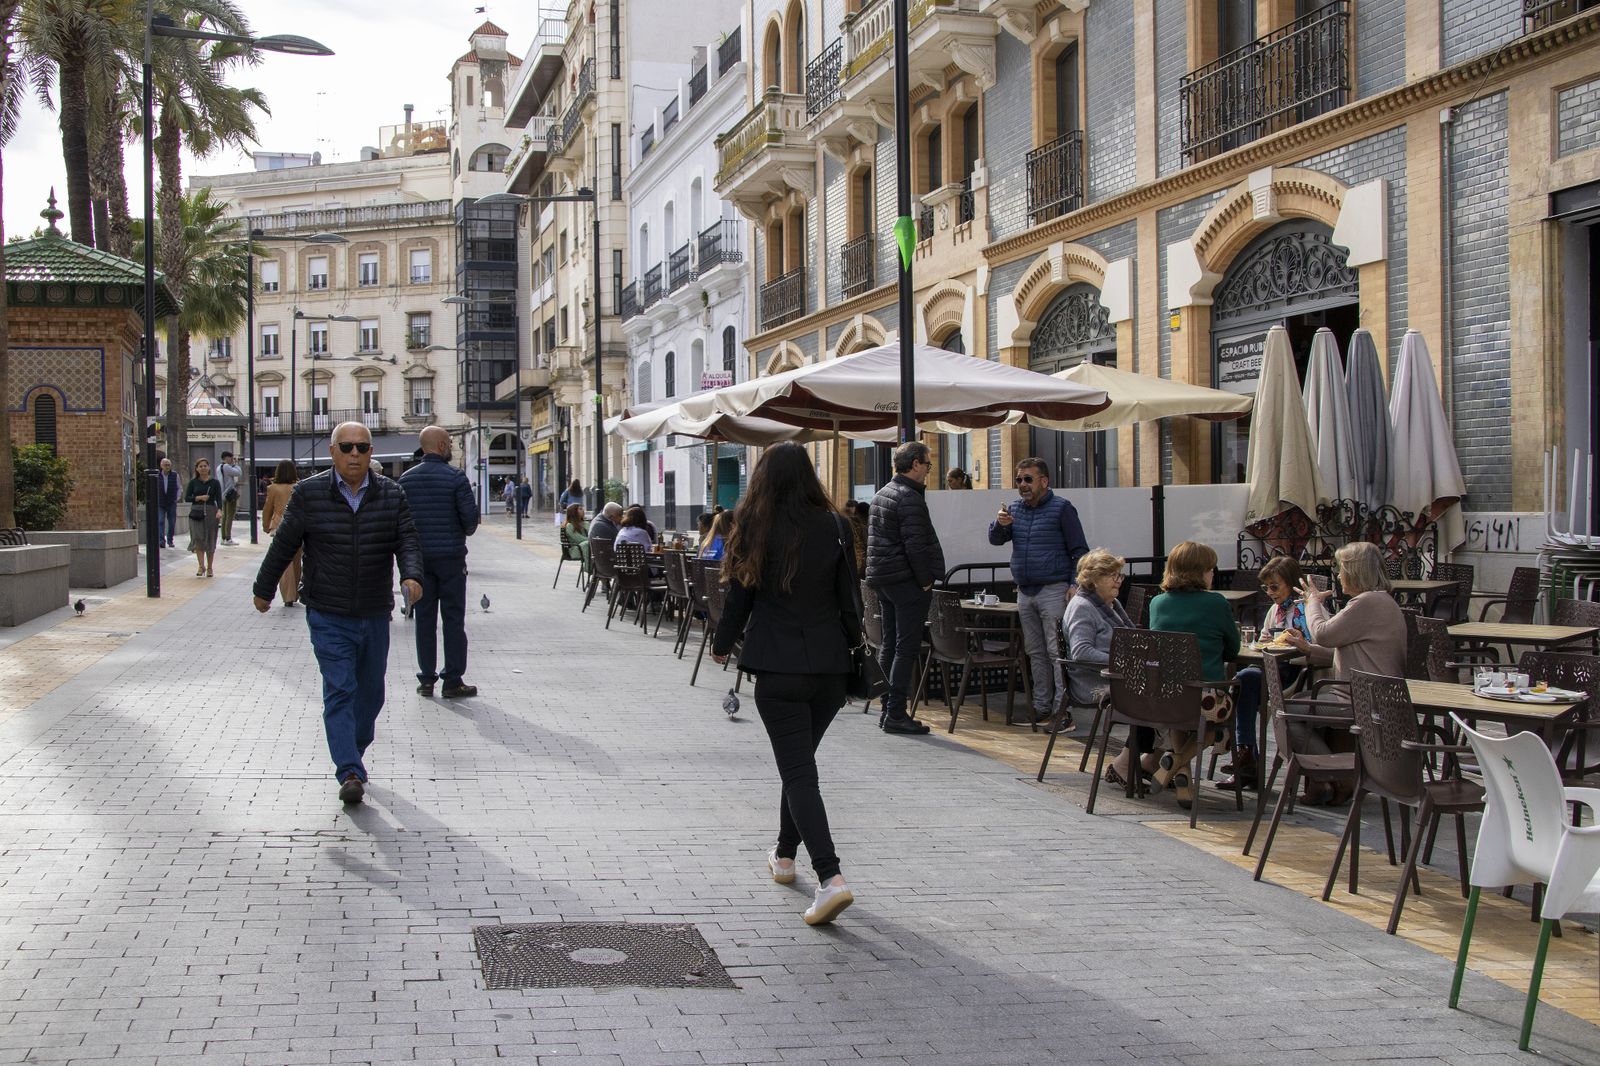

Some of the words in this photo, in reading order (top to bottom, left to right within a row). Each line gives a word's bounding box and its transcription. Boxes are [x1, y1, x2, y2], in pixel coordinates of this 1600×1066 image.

[1221, 344, 1248, 358] ESPACIO
[1249, 341, 1265, 353] RUB
[1232, 360, 1250, 370] CRAFT
[1251, 357, 1263, 367] BEE
[1511, 773, 1534, 842] Heineken
